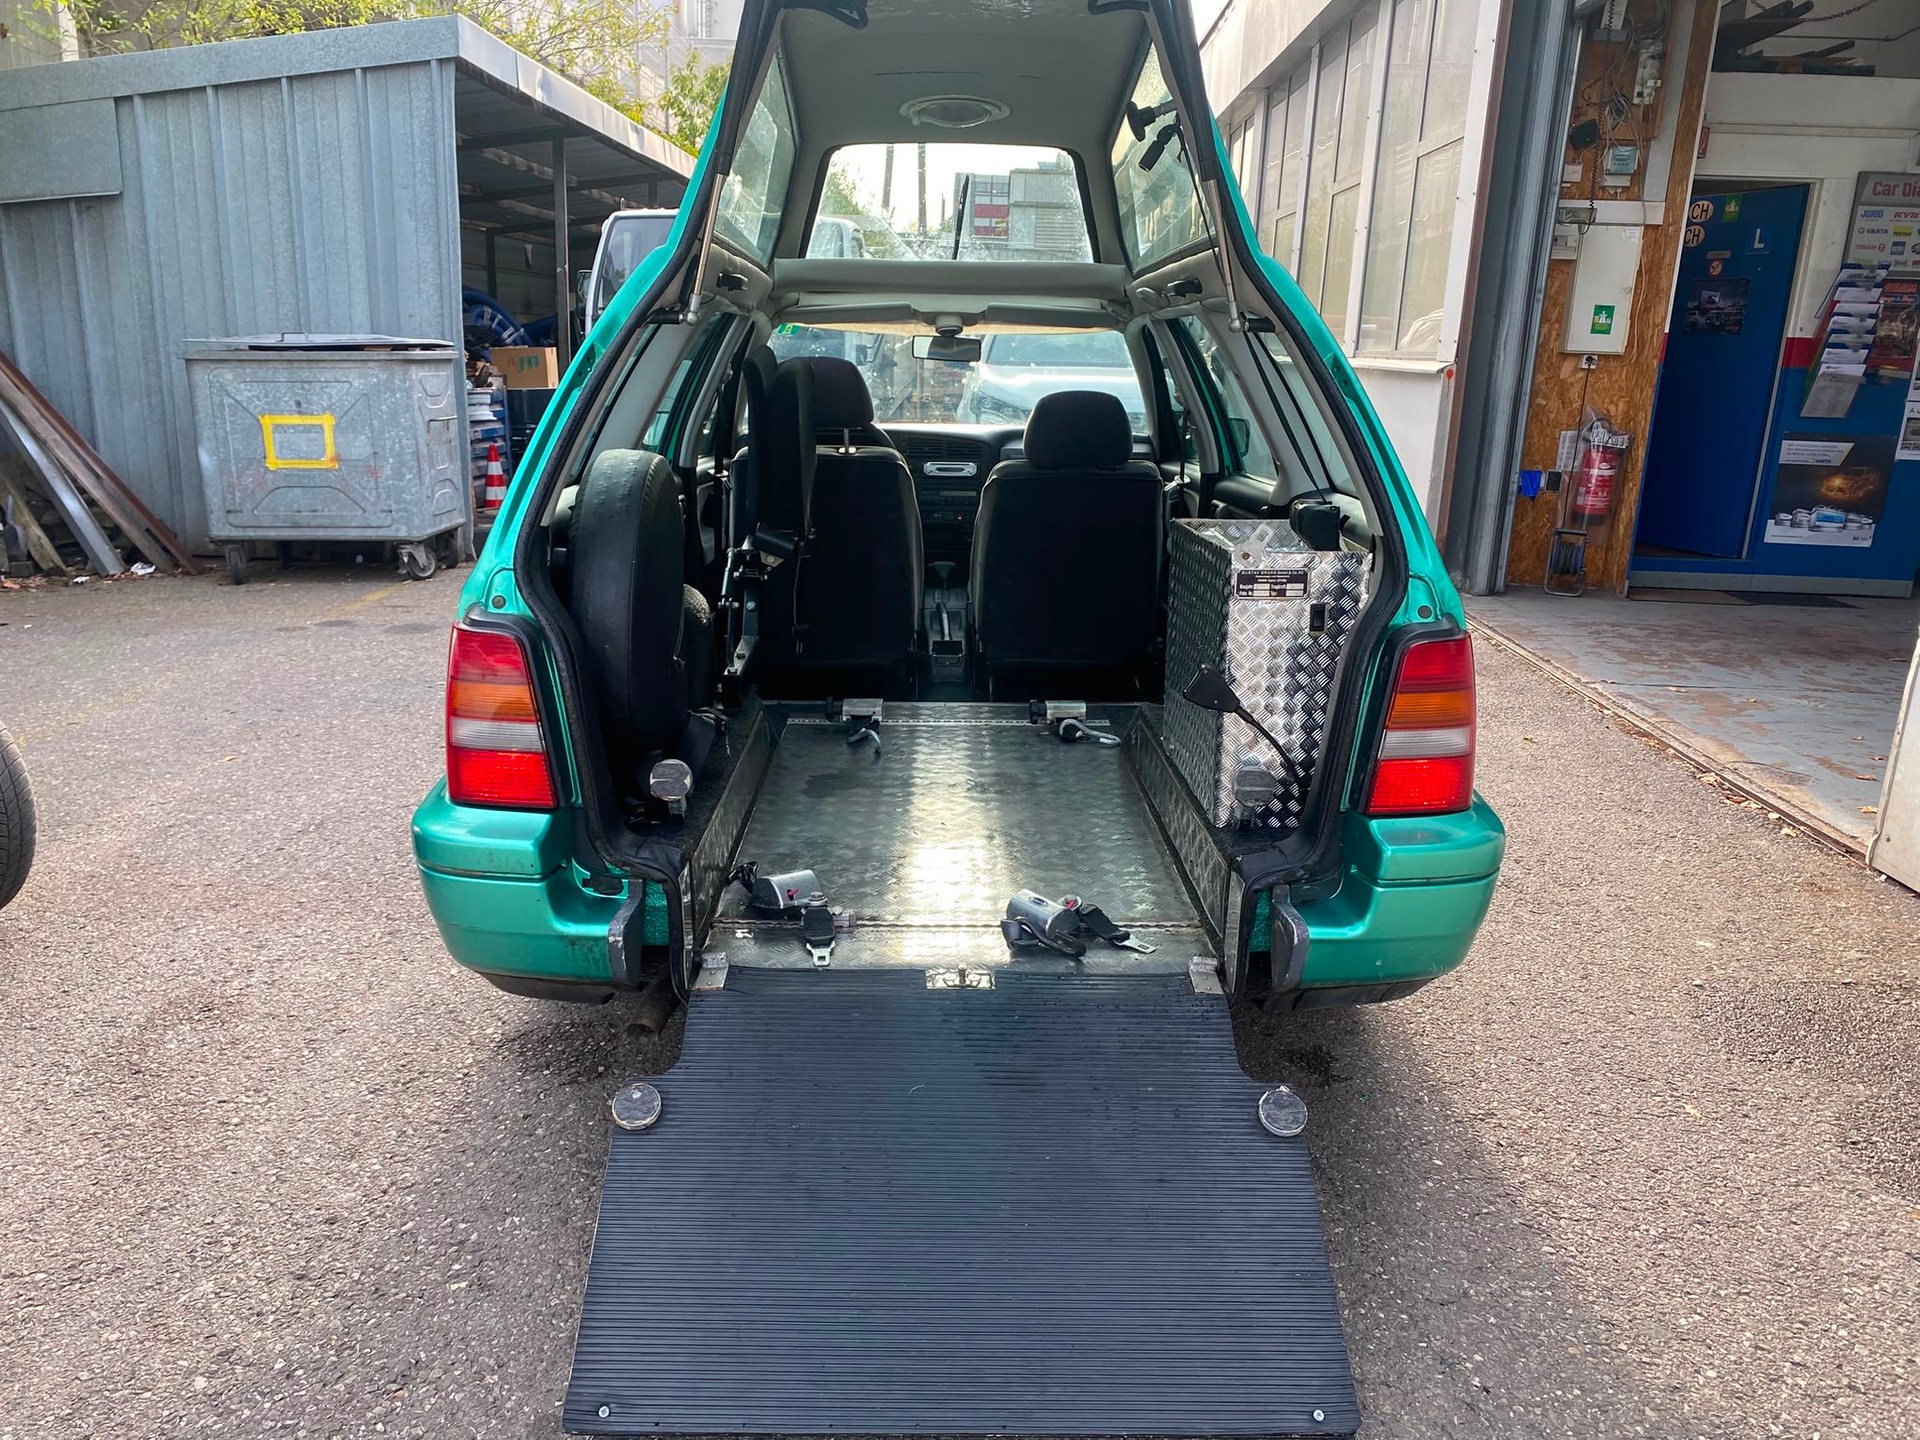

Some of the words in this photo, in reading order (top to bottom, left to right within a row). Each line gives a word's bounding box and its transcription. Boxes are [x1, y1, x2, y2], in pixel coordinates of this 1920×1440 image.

[1872, 181, 1899, 196] Car
[1691, 203, 1710, 219] CH
[1684, 228, 1701, 244] CH
[1753, 228, 1765, 249] L
